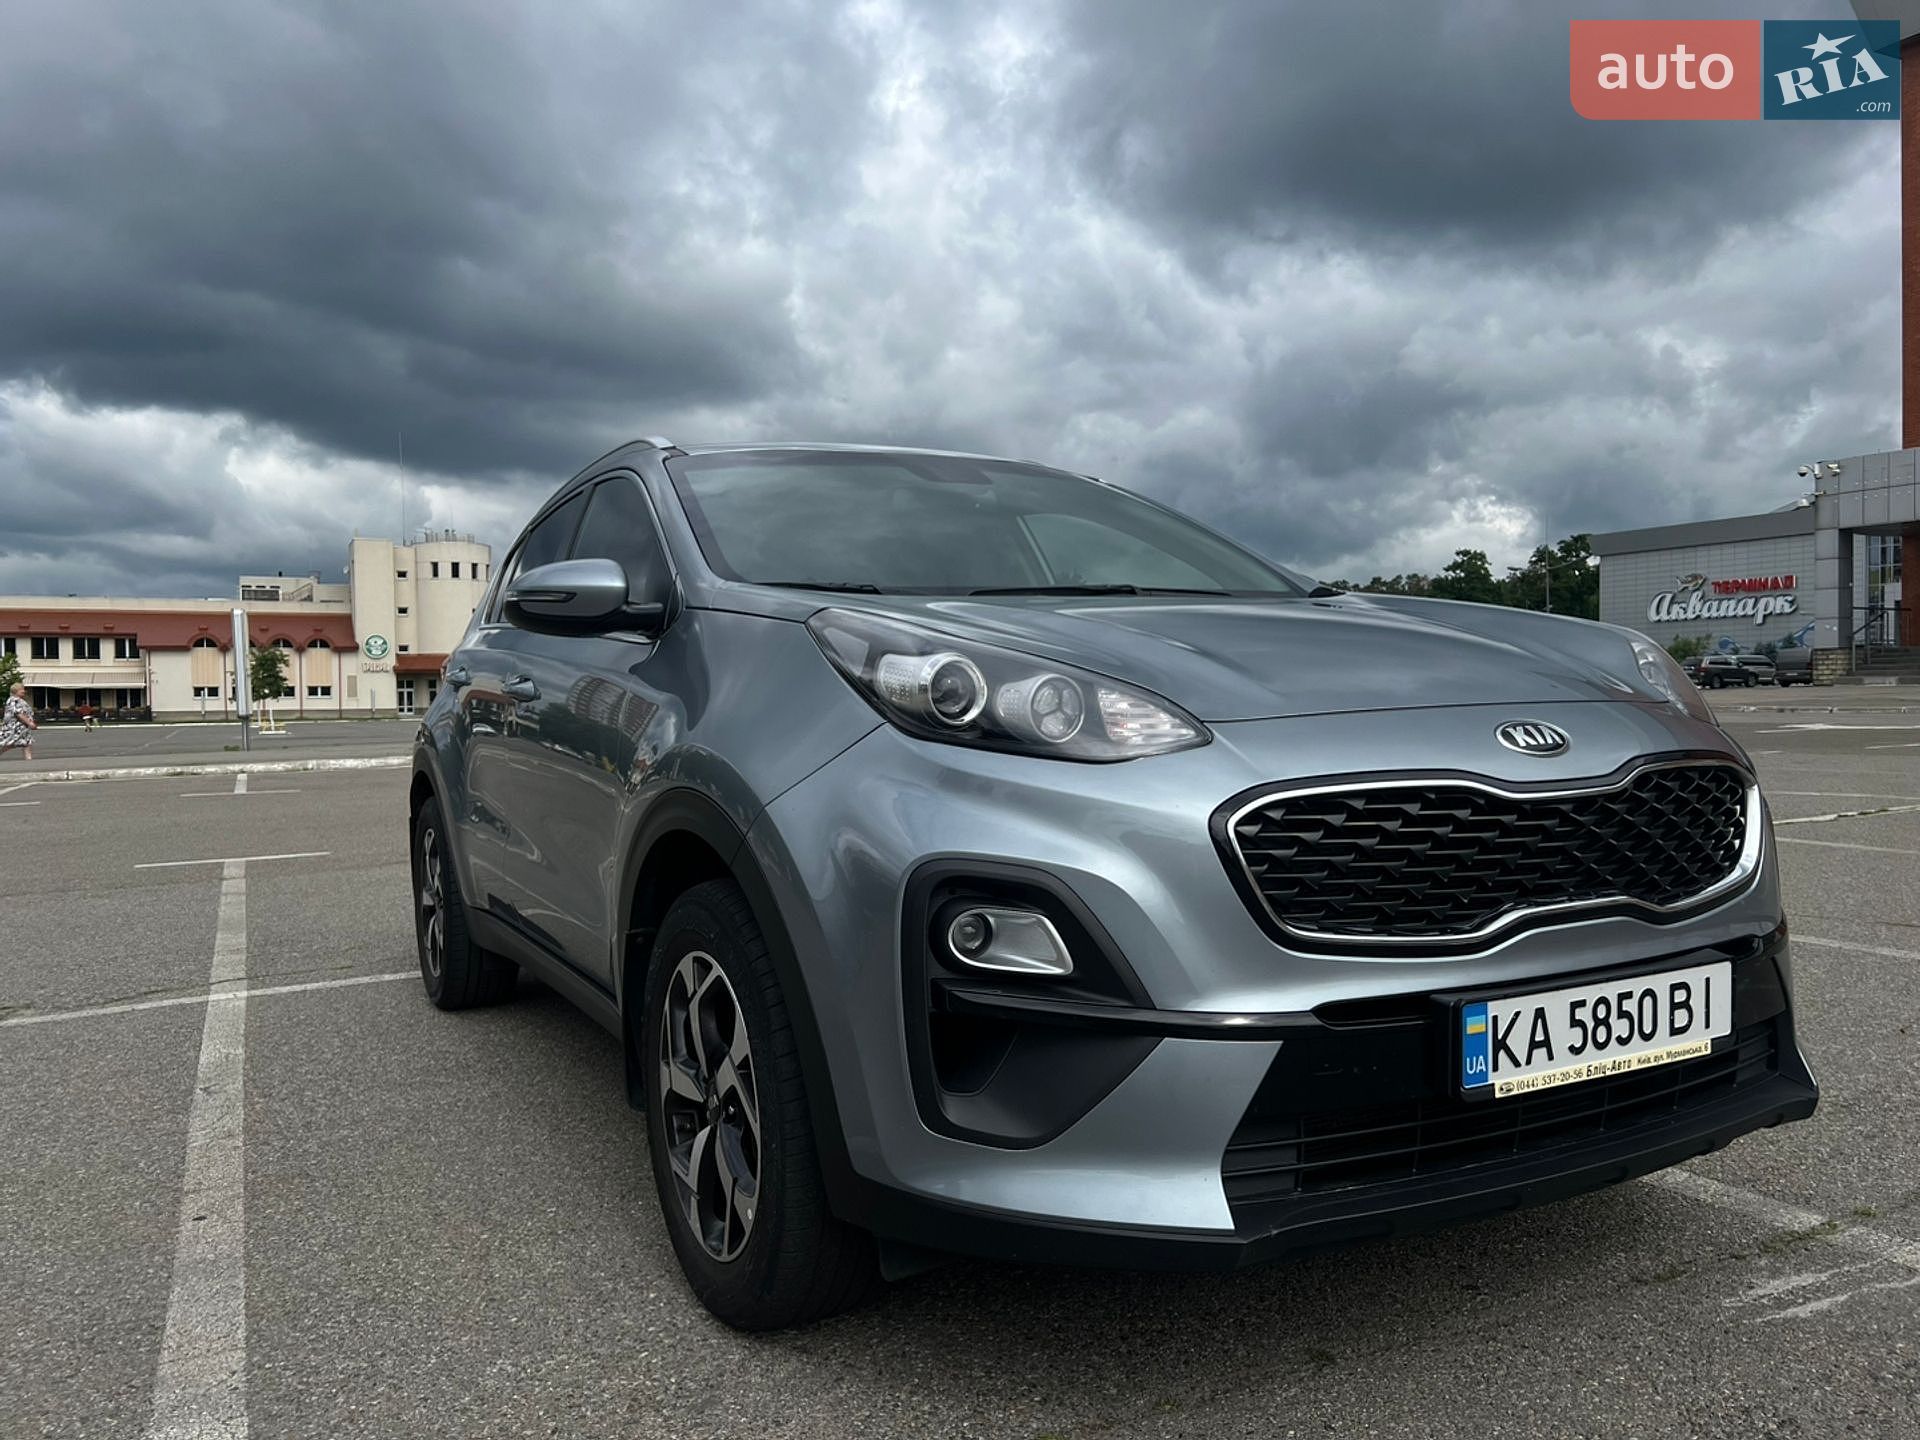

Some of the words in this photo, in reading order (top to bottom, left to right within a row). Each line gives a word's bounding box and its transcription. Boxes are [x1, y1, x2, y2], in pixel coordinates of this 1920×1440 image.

[1647, 590, 1798, 625] Аквапарк
[1505, 725, 1563, 747] KIA
[1491, 1006, 1554, 1073] KA
[1567, 987, 1659, 1056] 5850
[1669, 976, 1712, 1038] BI
[1465, 1055, 1487, 1075] UA
[1586, 1059, 1632, 1078] Бліц-Авто
